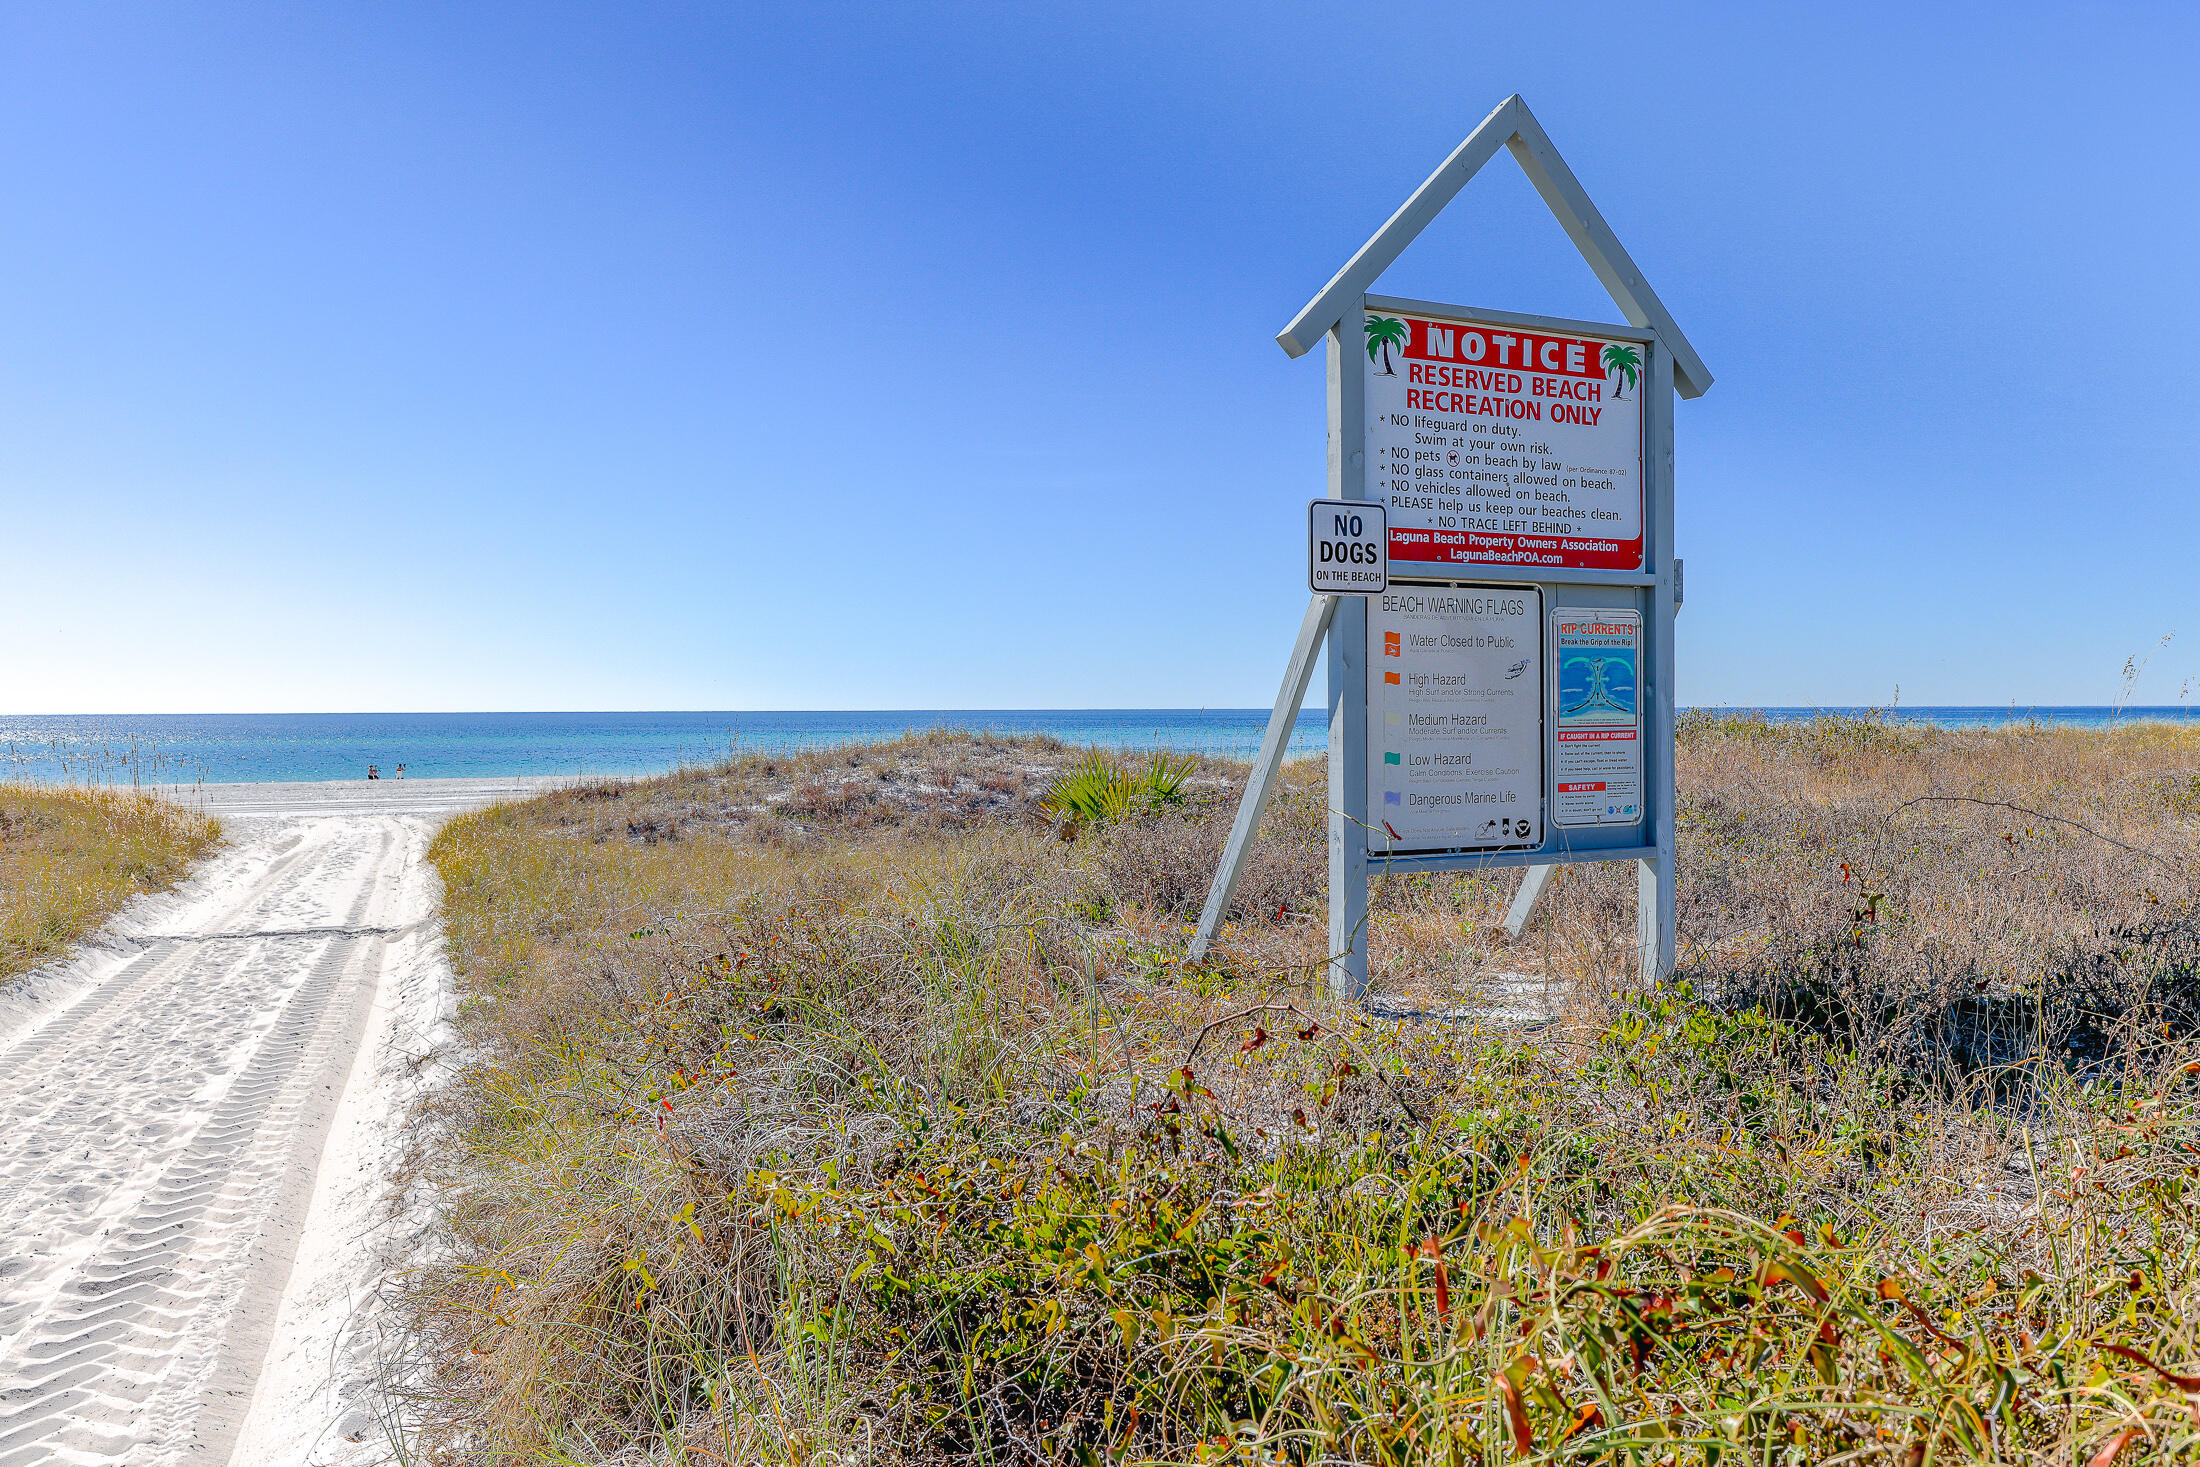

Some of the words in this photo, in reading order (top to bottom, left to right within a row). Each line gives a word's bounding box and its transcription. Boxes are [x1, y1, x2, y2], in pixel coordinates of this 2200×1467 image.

[1427, 327, 1586, 373] NOTICE
[1409, 363, 1523, 394] RESERVED
[1532, 377, 1601, 402] BEACH
[1406, 388, 1541, 421] RECREATION
[1550, 404, 1602, 426] ONLY
[1391, 414, 1409, 426] NO
[1415, 415, 1467, 432] lifeguard
[1472, 424, 1487, 433] on
[1492, 423, 1521, 439] duty.
[1415, 433, 1446, 446] Swim
[1452, 437, 1464, 447] at
[1469, 440, 1495, 451] your
[1500, 442, 1525, 452] own
[1530, 442, 1552, 455] risk.
[1391, 447, 1409, 459] NO
[1415, 450, 1440, 462] pets
[1465, 455, 1479, 464] on
[1485, 454, 1518, 467] beach
[1523, 456, 1536, 472] by
[1542, 458, 1561, 470] law
[1391, 463, 1409, 475] NO
[1415, 465, 1443, 479] glass
[1449, 469, 1508, 482] containers
[1513, 472, 1557, 486] allowed
[1562, 478, 1576, 487] on
[1581, 476, 1616, 490] beach.
[1391, 480, 1409, 491] NO
[1415, 481, 1460, 495] vehicles
[1466, 484, 1510, 498] allowed
[1516, 490, 1529, 500] on
[1535, 489, 1570, 502] beach.
[1391, 496, 1433, 509] PLEASE
[1439, 498, 1463, 514] help
[1468, 503, 1480, 512] us
[1486, 501, 1513, 517] keep
[1518, 506, 1537, 515] our
[1542, 505, 1585, 519] beaches
[1591, 508, 1621, 520] clean.
[1334, 515, 1362, 537] NO
[1439, 516, 1456, 528] NO
[1461, 517, 1497, 530] TRACE
[1503, 520, 1527, 532] LEFT
[1532, 522, 1571, 534] BEHIND
[1390, 530, 1429, 544] Laguna
[1433, 532, 1465, 545] Beach
[1469, 534, 1514, 549] Property
[1518, 537, 1557, 549] Owners
[1561, 539, 1618, 552] Association
[1320, 541, 1377, 564] DOGS
[1450, 548, 1563, 564] LagunaBeachPOA.com
[1316, 570, 1328, 580] ON
[1332, 571, 1348, 581] THE
[1352, 572, 1381, 582] BEACH
[1382, 596, 1424, 612] BEACH
[1428, 597, 1483, 615] WARNING
[1487, 599, 1524, 615] FLAGS
[1561, 623, 1577, 634] RIP
[1581, 623, 1633, 635] CURRENTS
[1409, 634, 1437, 646] Water
[1440, 634, 1473, 647] Closed
[1476, 637, 1484, 647] to
[1487, 636, 1515, 648] Public
[1590, 639, 1602, 647] Grip
[1408, 673, 1429, 688] High
[1433, 673, 1466, 685] Hazard
[1408, 689, 1424, 697] High
[1464, 689, 1484, 697] Strong
[1409, 713, 1447, 725] Medium
[1451, 713, 1487, 725] Hazard
[1409, 753, 1430, 766] Low
[1434, 753, 1471, 765] Hazard
[1409, 769, 1426, 777] Calm
[1409, 794, 1461, 808] Dangerous
[1465, 792, 1497, 803] Marine
[1499, 791, 1516, 803] Life
